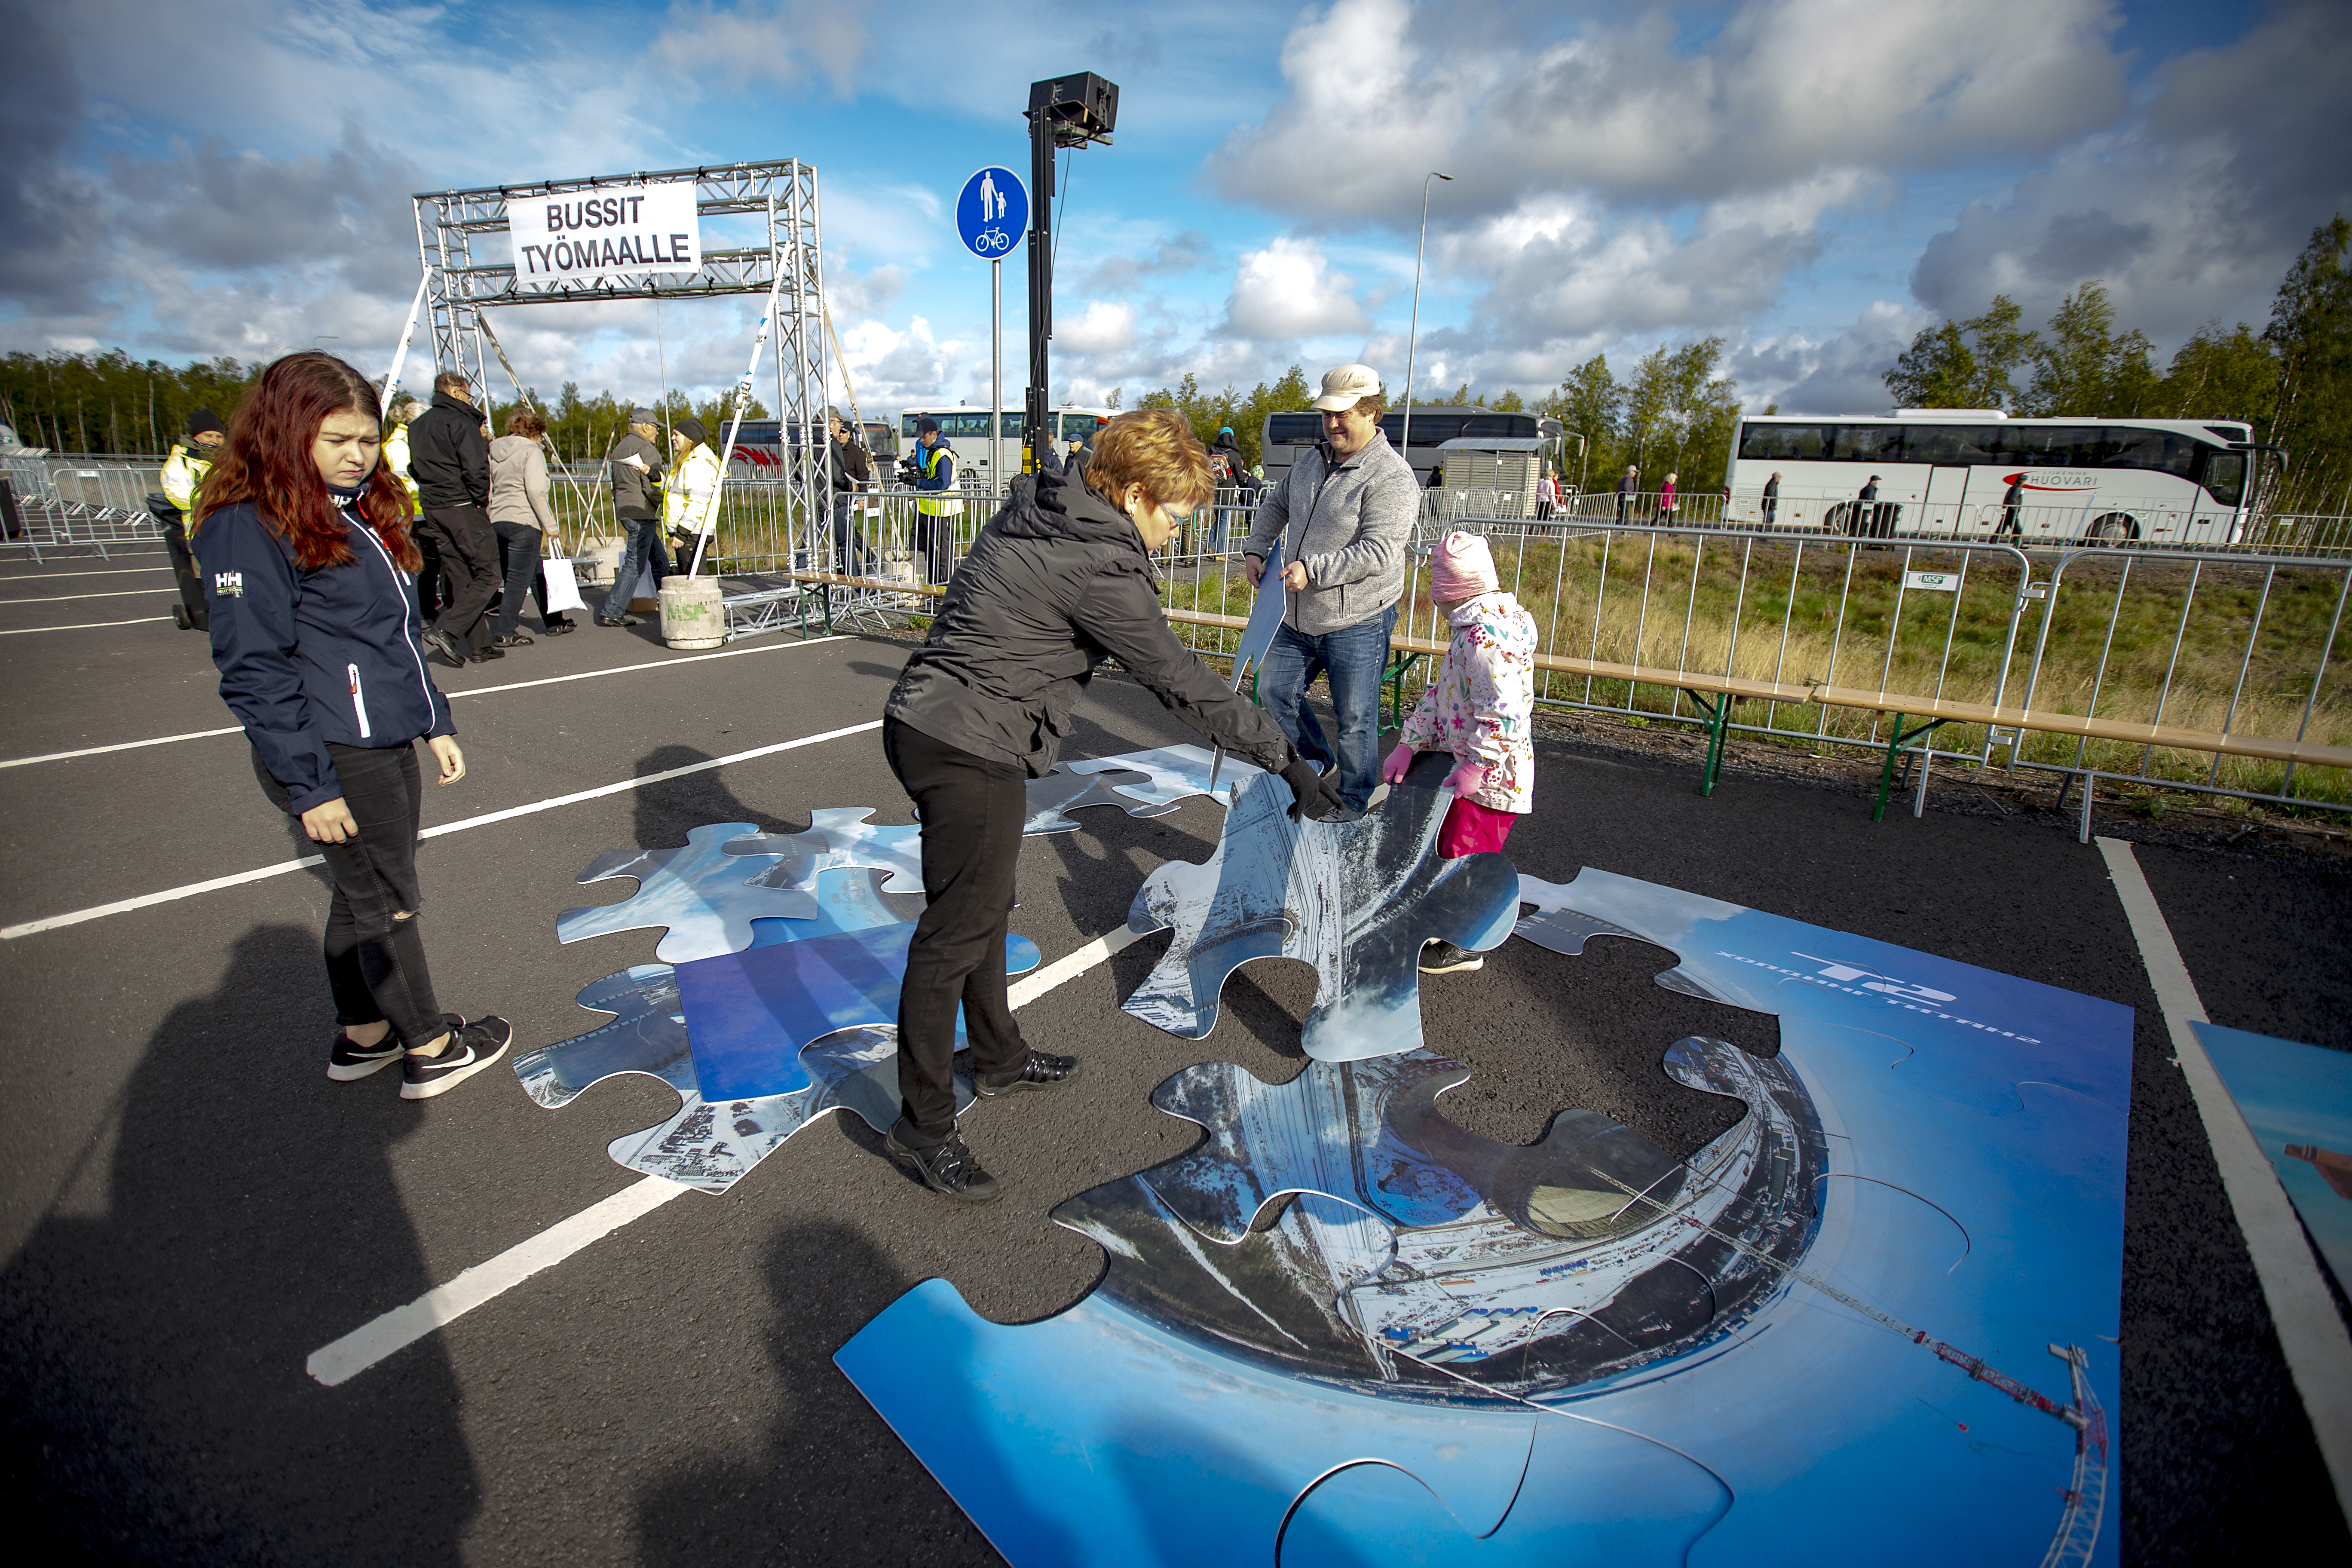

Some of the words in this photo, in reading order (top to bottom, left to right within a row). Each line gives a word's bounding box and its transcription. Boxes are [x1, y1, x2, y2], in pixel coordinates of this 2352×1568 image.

[547, 196, 644, 232] BUSSIT
[521, 234, 691, 273] TYÖMAALLE
[2030, 475, 2098, 486] HUOVARI
[214, 572, 242, 588] HH
[1922, 575, 1943, 583] MSP
[667, 603, 706, 622] MSP
